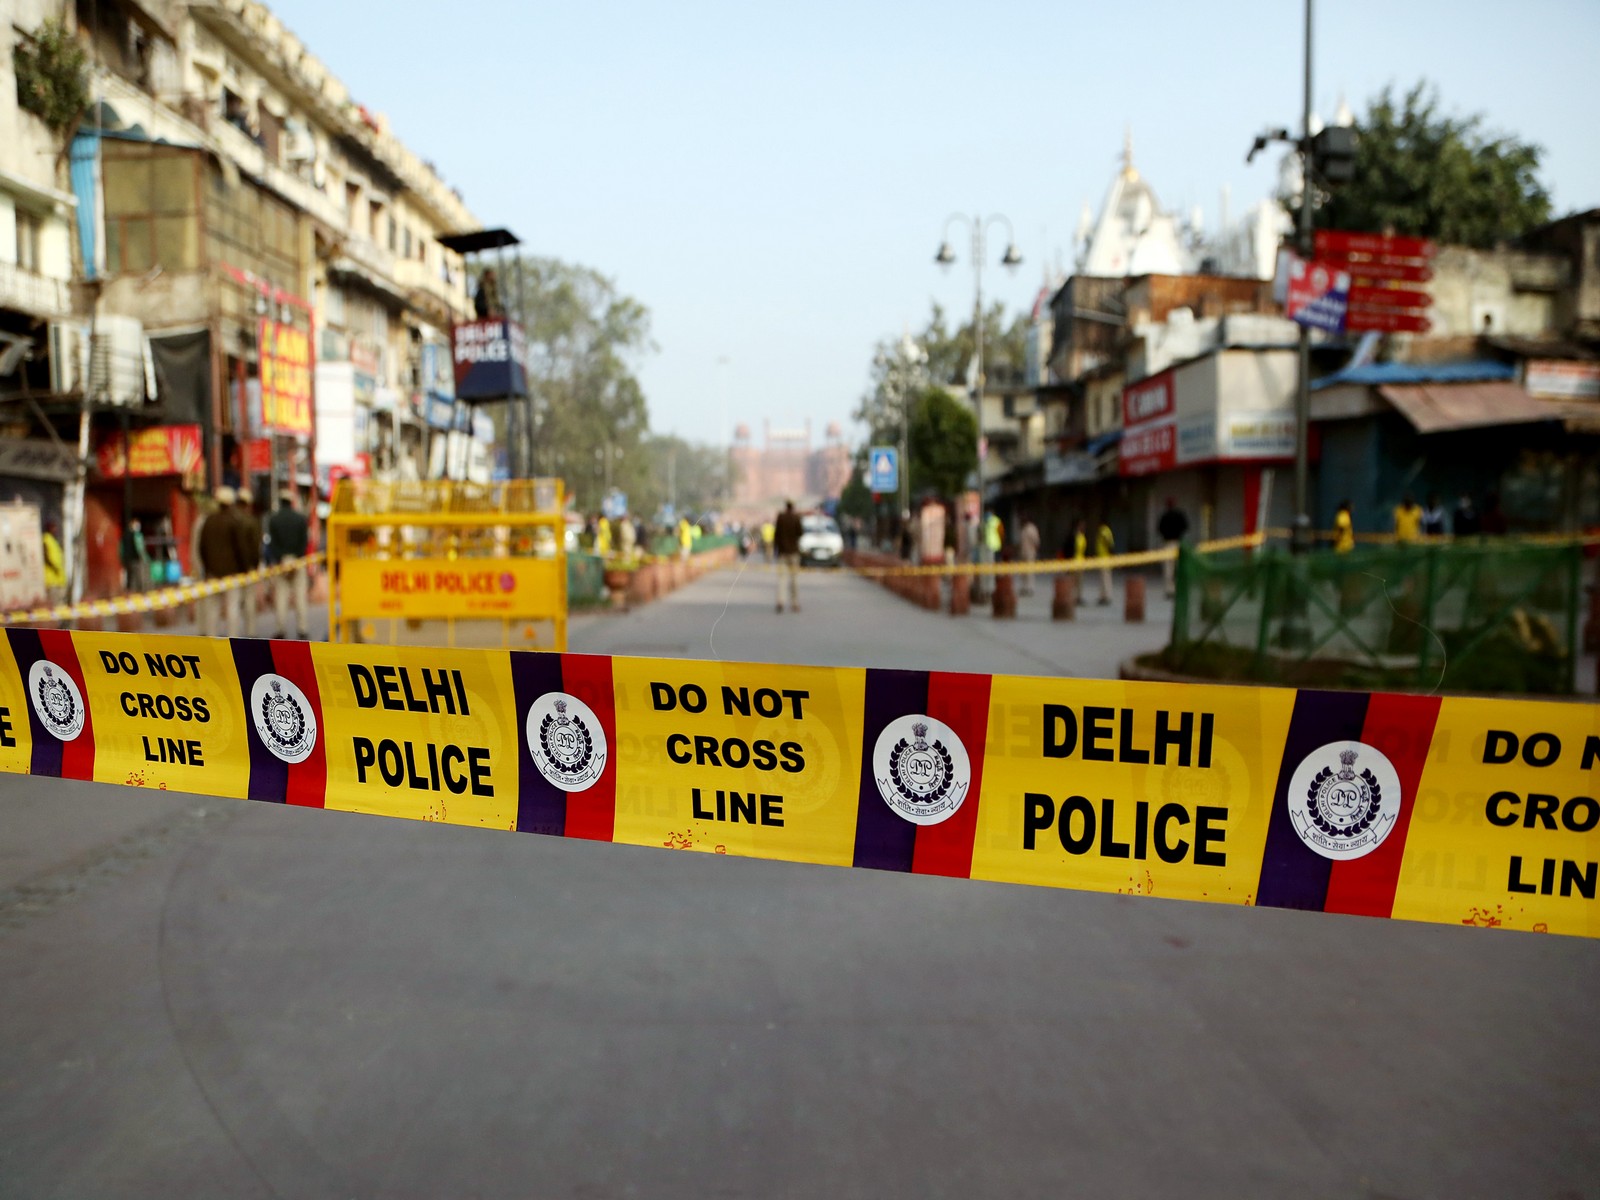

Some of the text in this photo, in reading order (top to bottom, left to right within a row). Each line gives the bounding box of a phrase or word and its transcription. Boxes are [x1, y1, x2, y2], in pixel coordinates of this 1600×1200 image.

[455, 340, 508, 364] POLICE
[381, 571, 497, 595] DELHI POLICE
[99, 651, 201, 680] DO NOT
[120, 691, 210, 723] CROSS
[347, 663, 470, 716] DELHI
[650, 681, 810, 721] DO NOT
[143, 736, 204, 767] LINE
[666, 733, 805, 774] CROSS
[1043, 703, 1215, 769] DELHI
[1482, 729, 1562, 768] DO
[352, 736, 495, 798] POLICE
[691, 788, 785, 827] LINE
[1320, 777, 1336, 819] DELHI POLICE
[1485, 791, 1600, 833] CRO
[1023, 792, 1229, 867] POLICE
[1507, 855, 1599, 900] LIN
